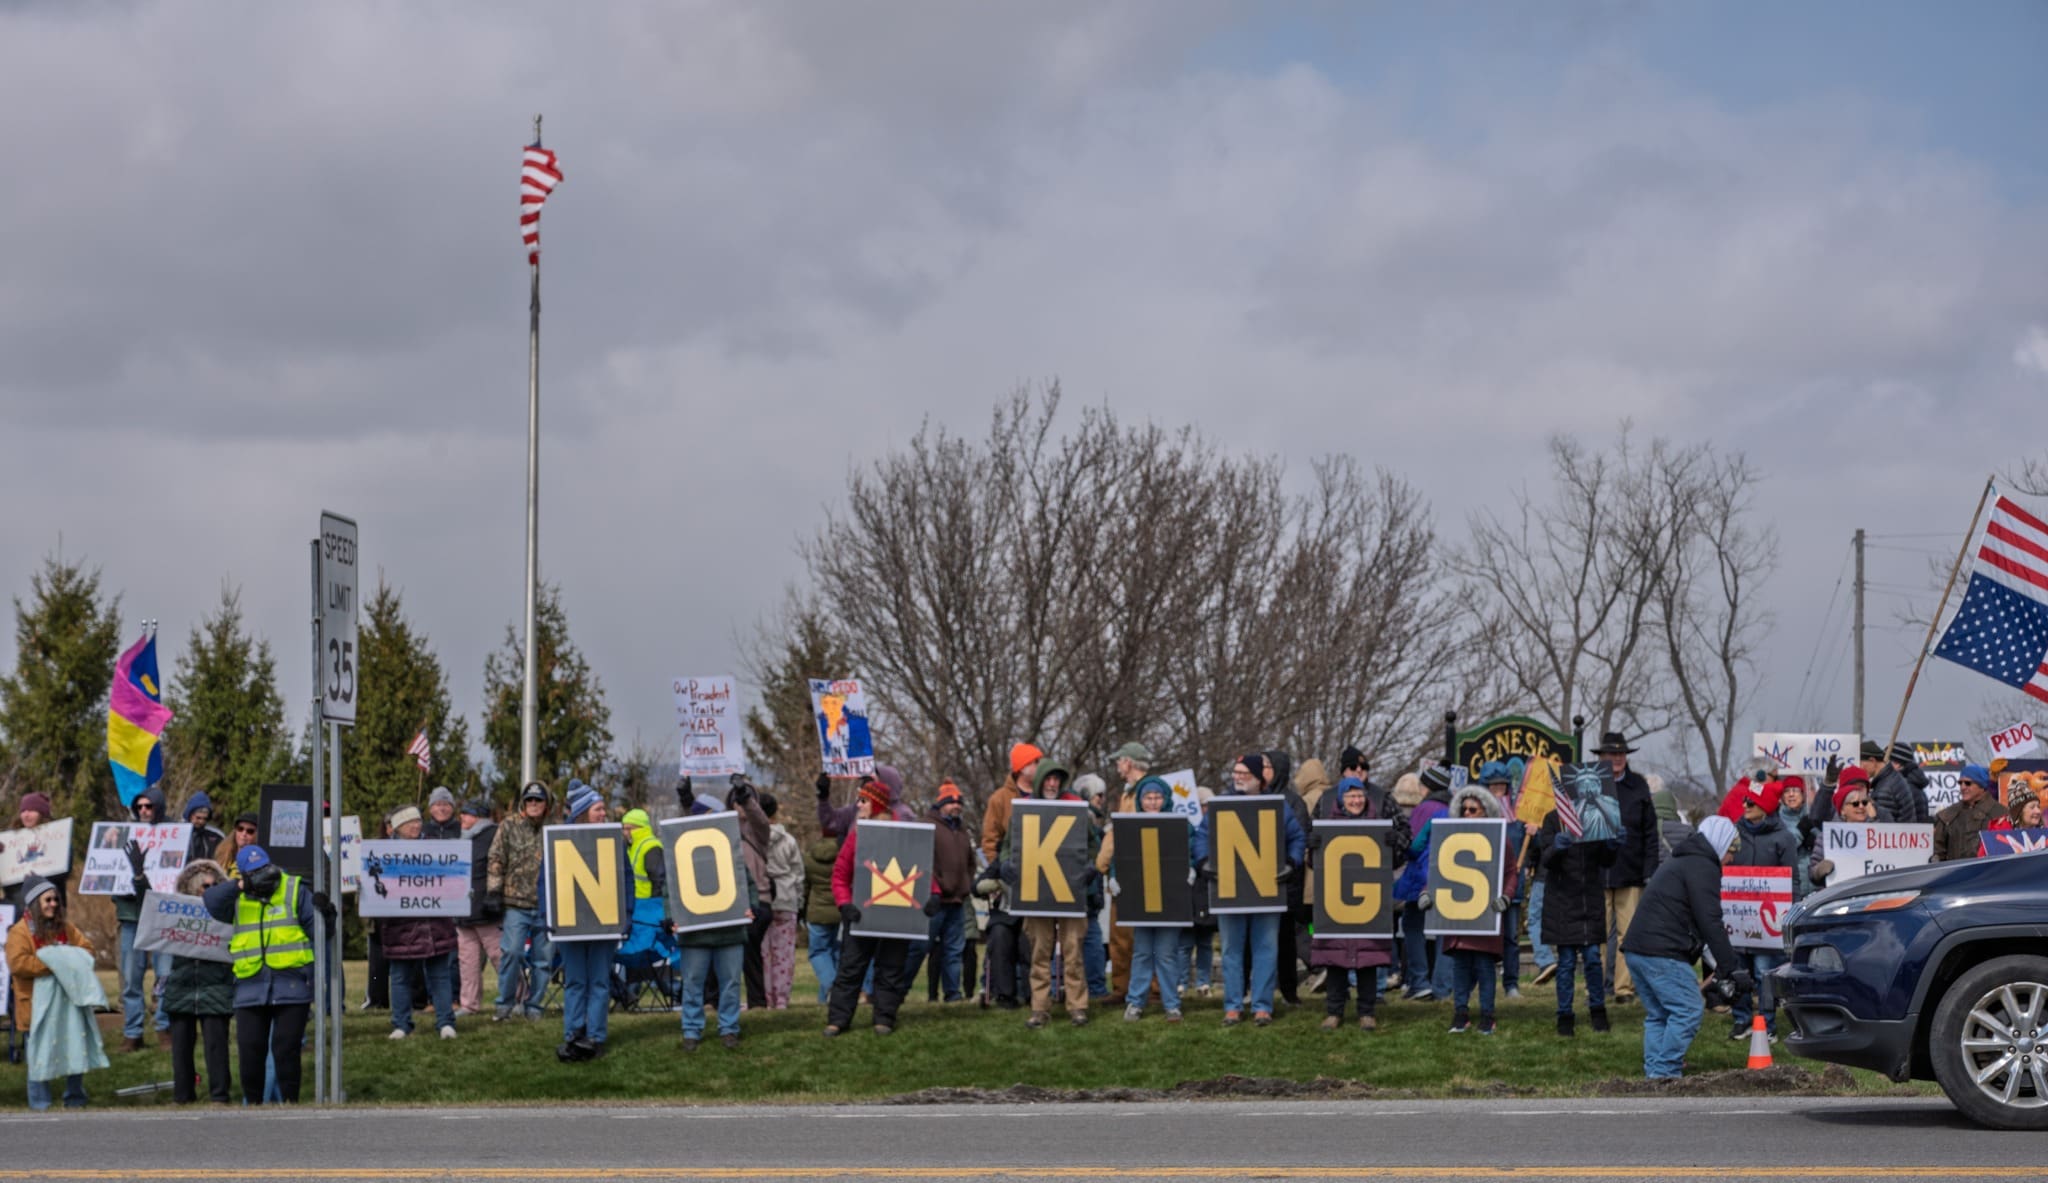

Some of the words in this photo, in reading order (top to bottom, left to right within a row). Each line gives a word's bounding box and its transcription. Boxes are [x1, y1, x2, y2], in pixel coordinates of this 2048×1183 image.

[324, 532, 354, 566] SPEED
[329, 581, 351, 612] LIMIT
[328, 637, 354, 703] 35
[1815, 738, 1841, 752] NO
[1990, 722, 2033, 753] PEDO
[1803, 756, 1856, 770] KINS
[1928, 774, 1957, 790] NO
[135, 826, 179, 841] WAKE
[1830, 828, 1858, 850] NO
[382, 853, 433, 867] STAND
[438, 853, 459, 867] UP
[398, 874, 446, 888] FIGHT
[400, 896, 442, 909] BACK
[176, 918, 210, 933] NOT
[161, 927, 220, 947] FASCISM
